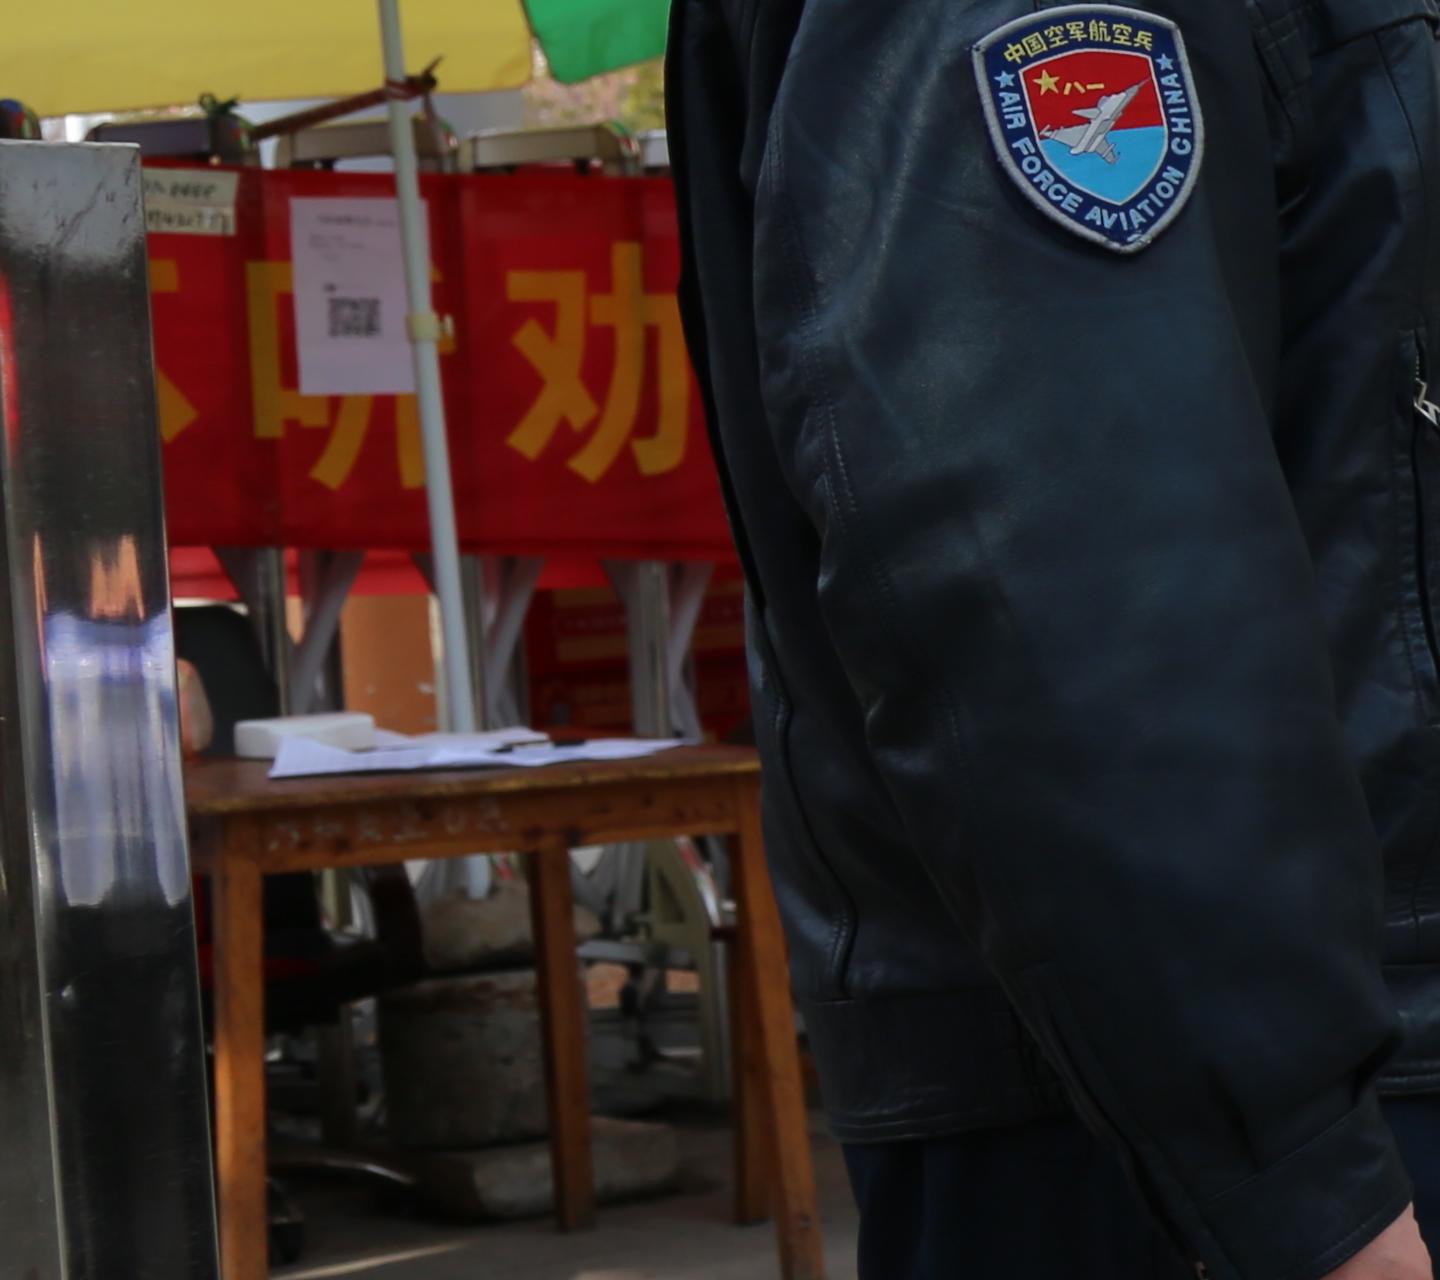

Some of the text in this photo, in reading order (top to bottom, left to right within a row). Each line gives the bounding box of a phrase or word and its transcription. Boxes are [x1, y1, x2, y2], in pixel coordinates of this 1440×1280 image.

[1003, 19, 1154, 64] 中国空军航空兵
[1063, 81, 1106, 96] 八一
[998, 74, 1191, 233] AIR FORCE AVIATION CHINA
